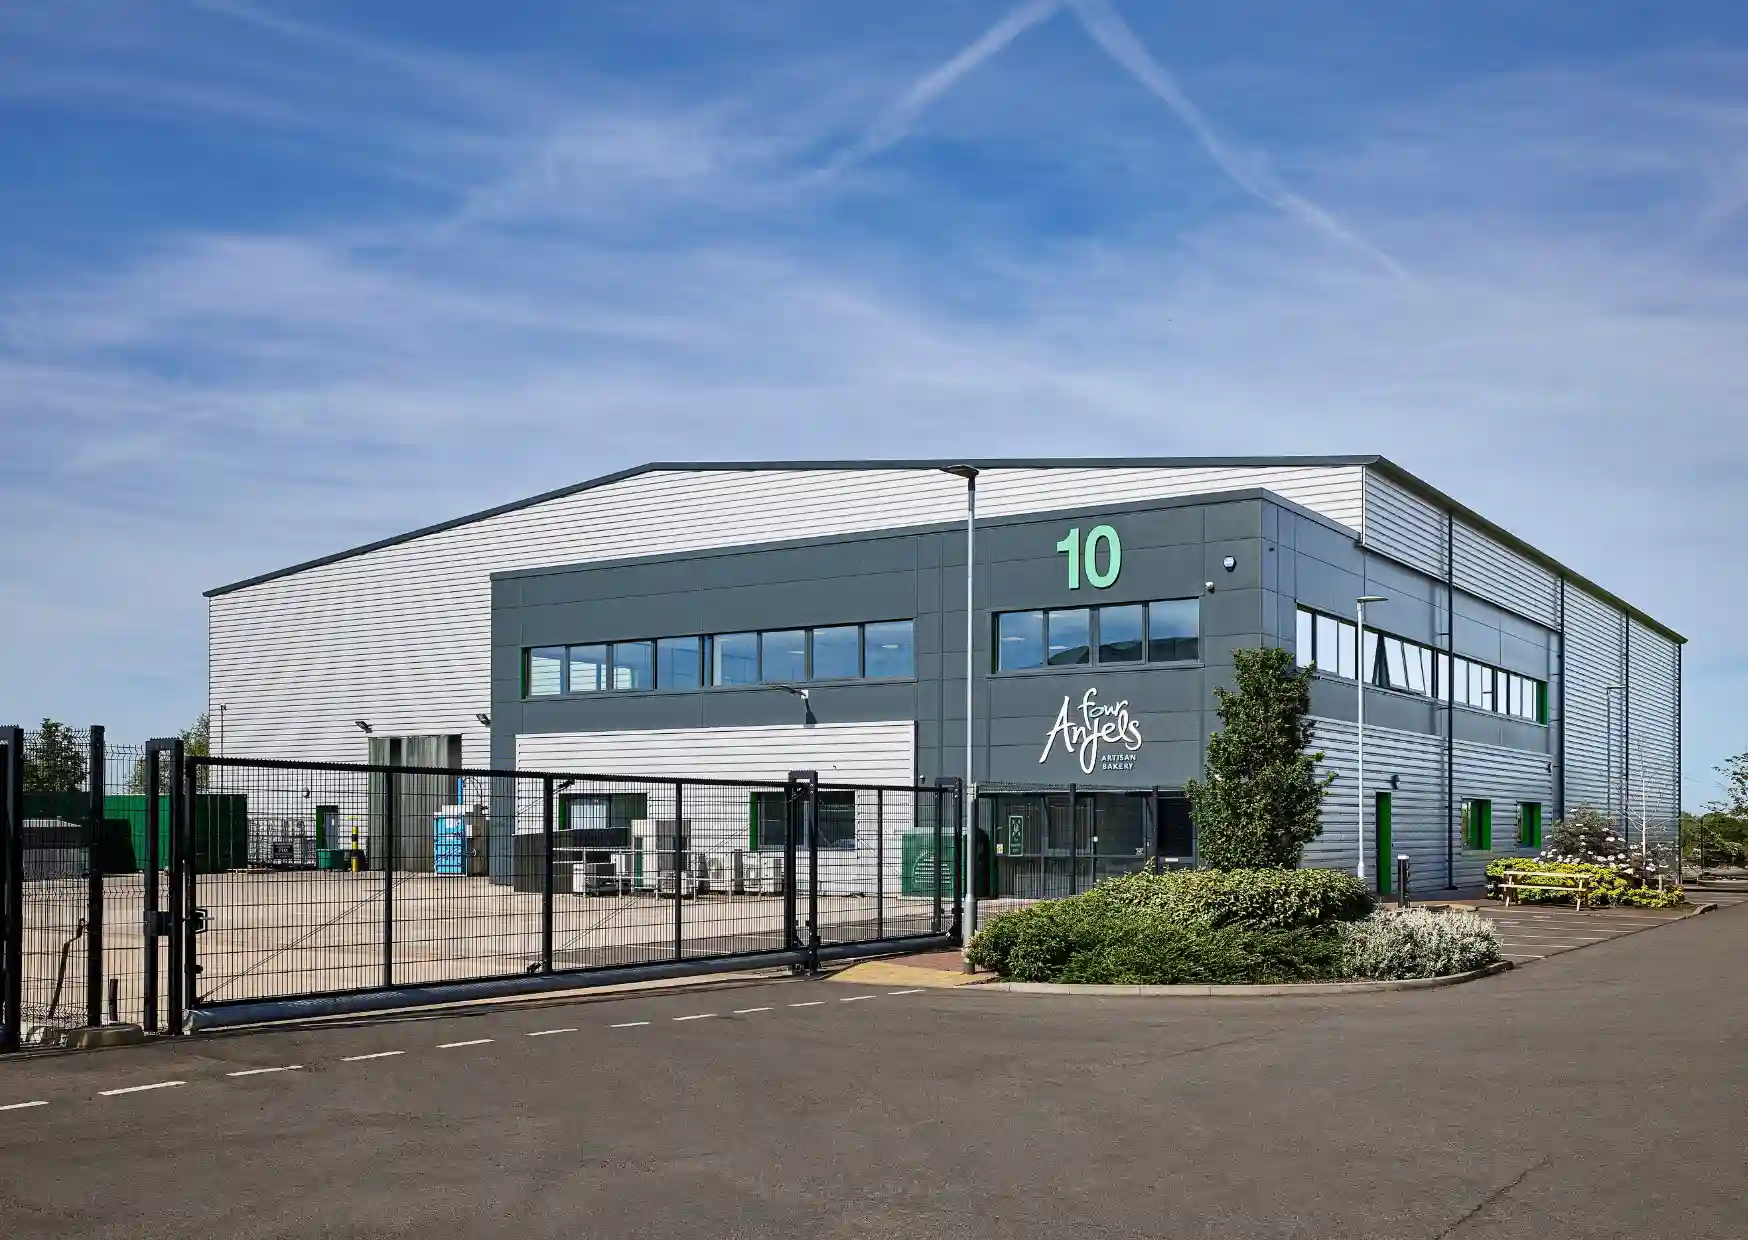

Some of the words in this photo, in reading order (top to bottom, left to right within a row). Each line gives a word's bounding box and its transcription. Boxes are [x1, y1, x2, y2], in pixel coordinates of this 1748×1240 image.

[1057, 524, 1121, 590] 10
[1077, 687, 1128, 731] four
[1101, 754, 1136, 762] ARTISAN
